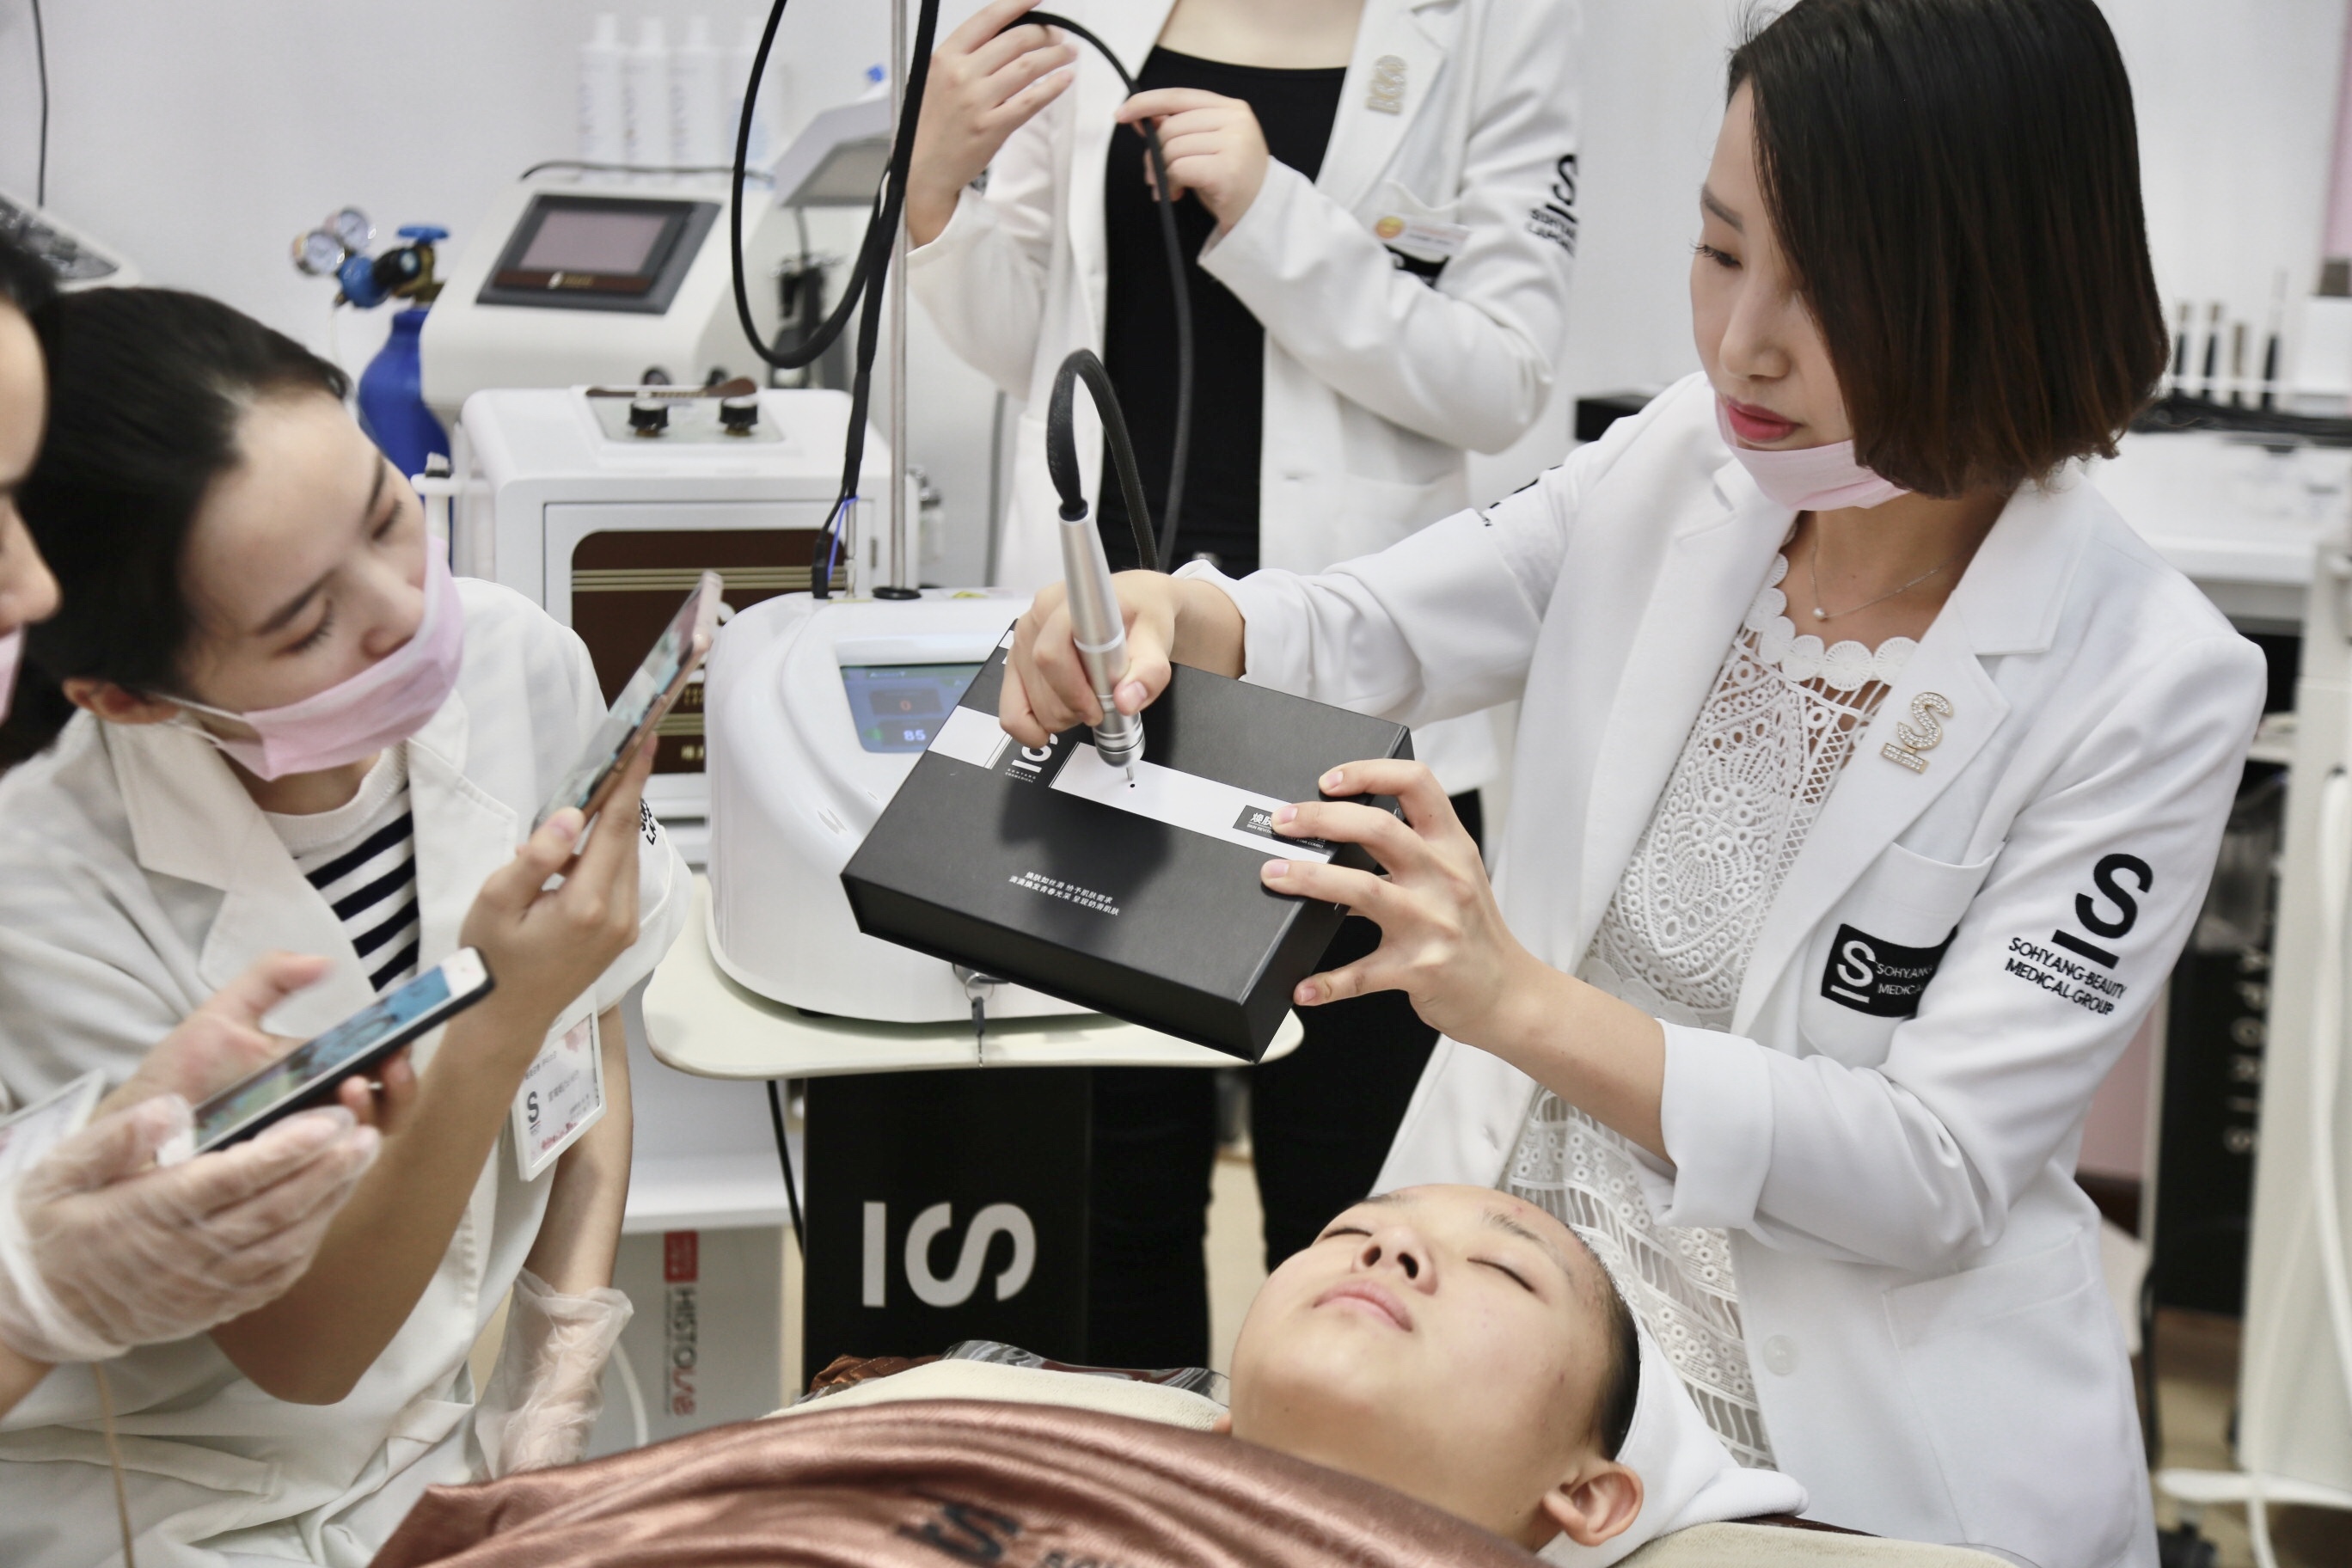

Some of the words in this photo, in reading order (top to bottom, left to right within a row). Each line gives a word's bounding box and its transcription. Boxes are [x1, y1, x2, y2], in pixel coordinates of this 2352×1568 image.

[903, 729, 926, 741] 85
[1250, 812, 1272, 827] 焕肤
[1876, 964, 1933, 979] SOHYAN
[2008, 937, 2086, 981] SOHYANG
[2085, 971, 2128, 999] BEAUTY
[2005, 958, 2071, 998] MEDICAL
[2072, 989, 2115, 1015] GROUP
